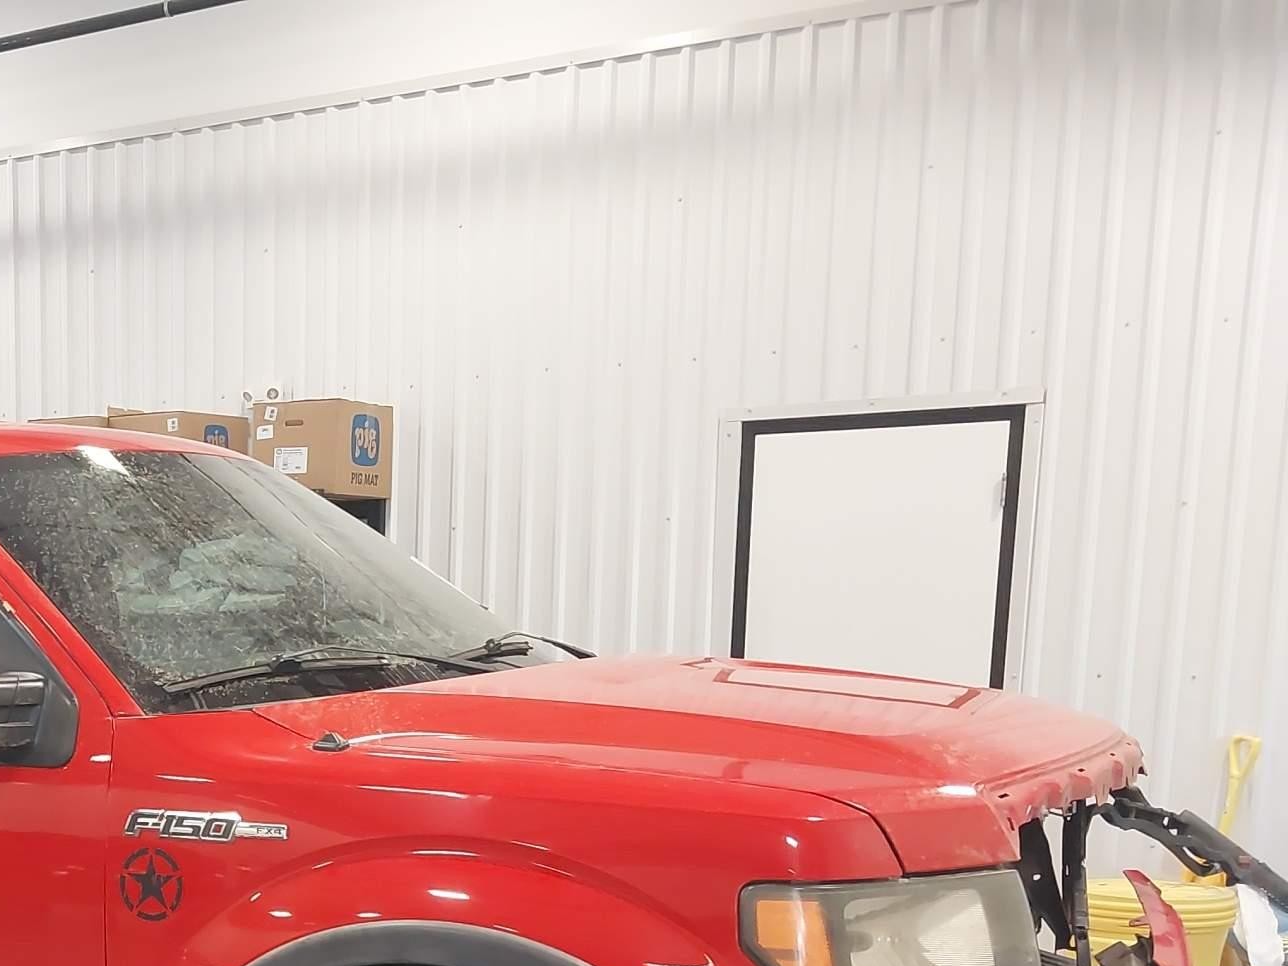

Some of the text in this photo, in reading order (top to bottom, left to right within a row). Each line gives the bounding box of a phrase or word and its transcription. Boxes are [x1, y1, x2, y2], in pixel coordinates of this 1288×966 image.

[354, 420, 377, 459] pig
[351, 471, 379, 487] PIG MAT
[256, 827, 282, 836] FX4
